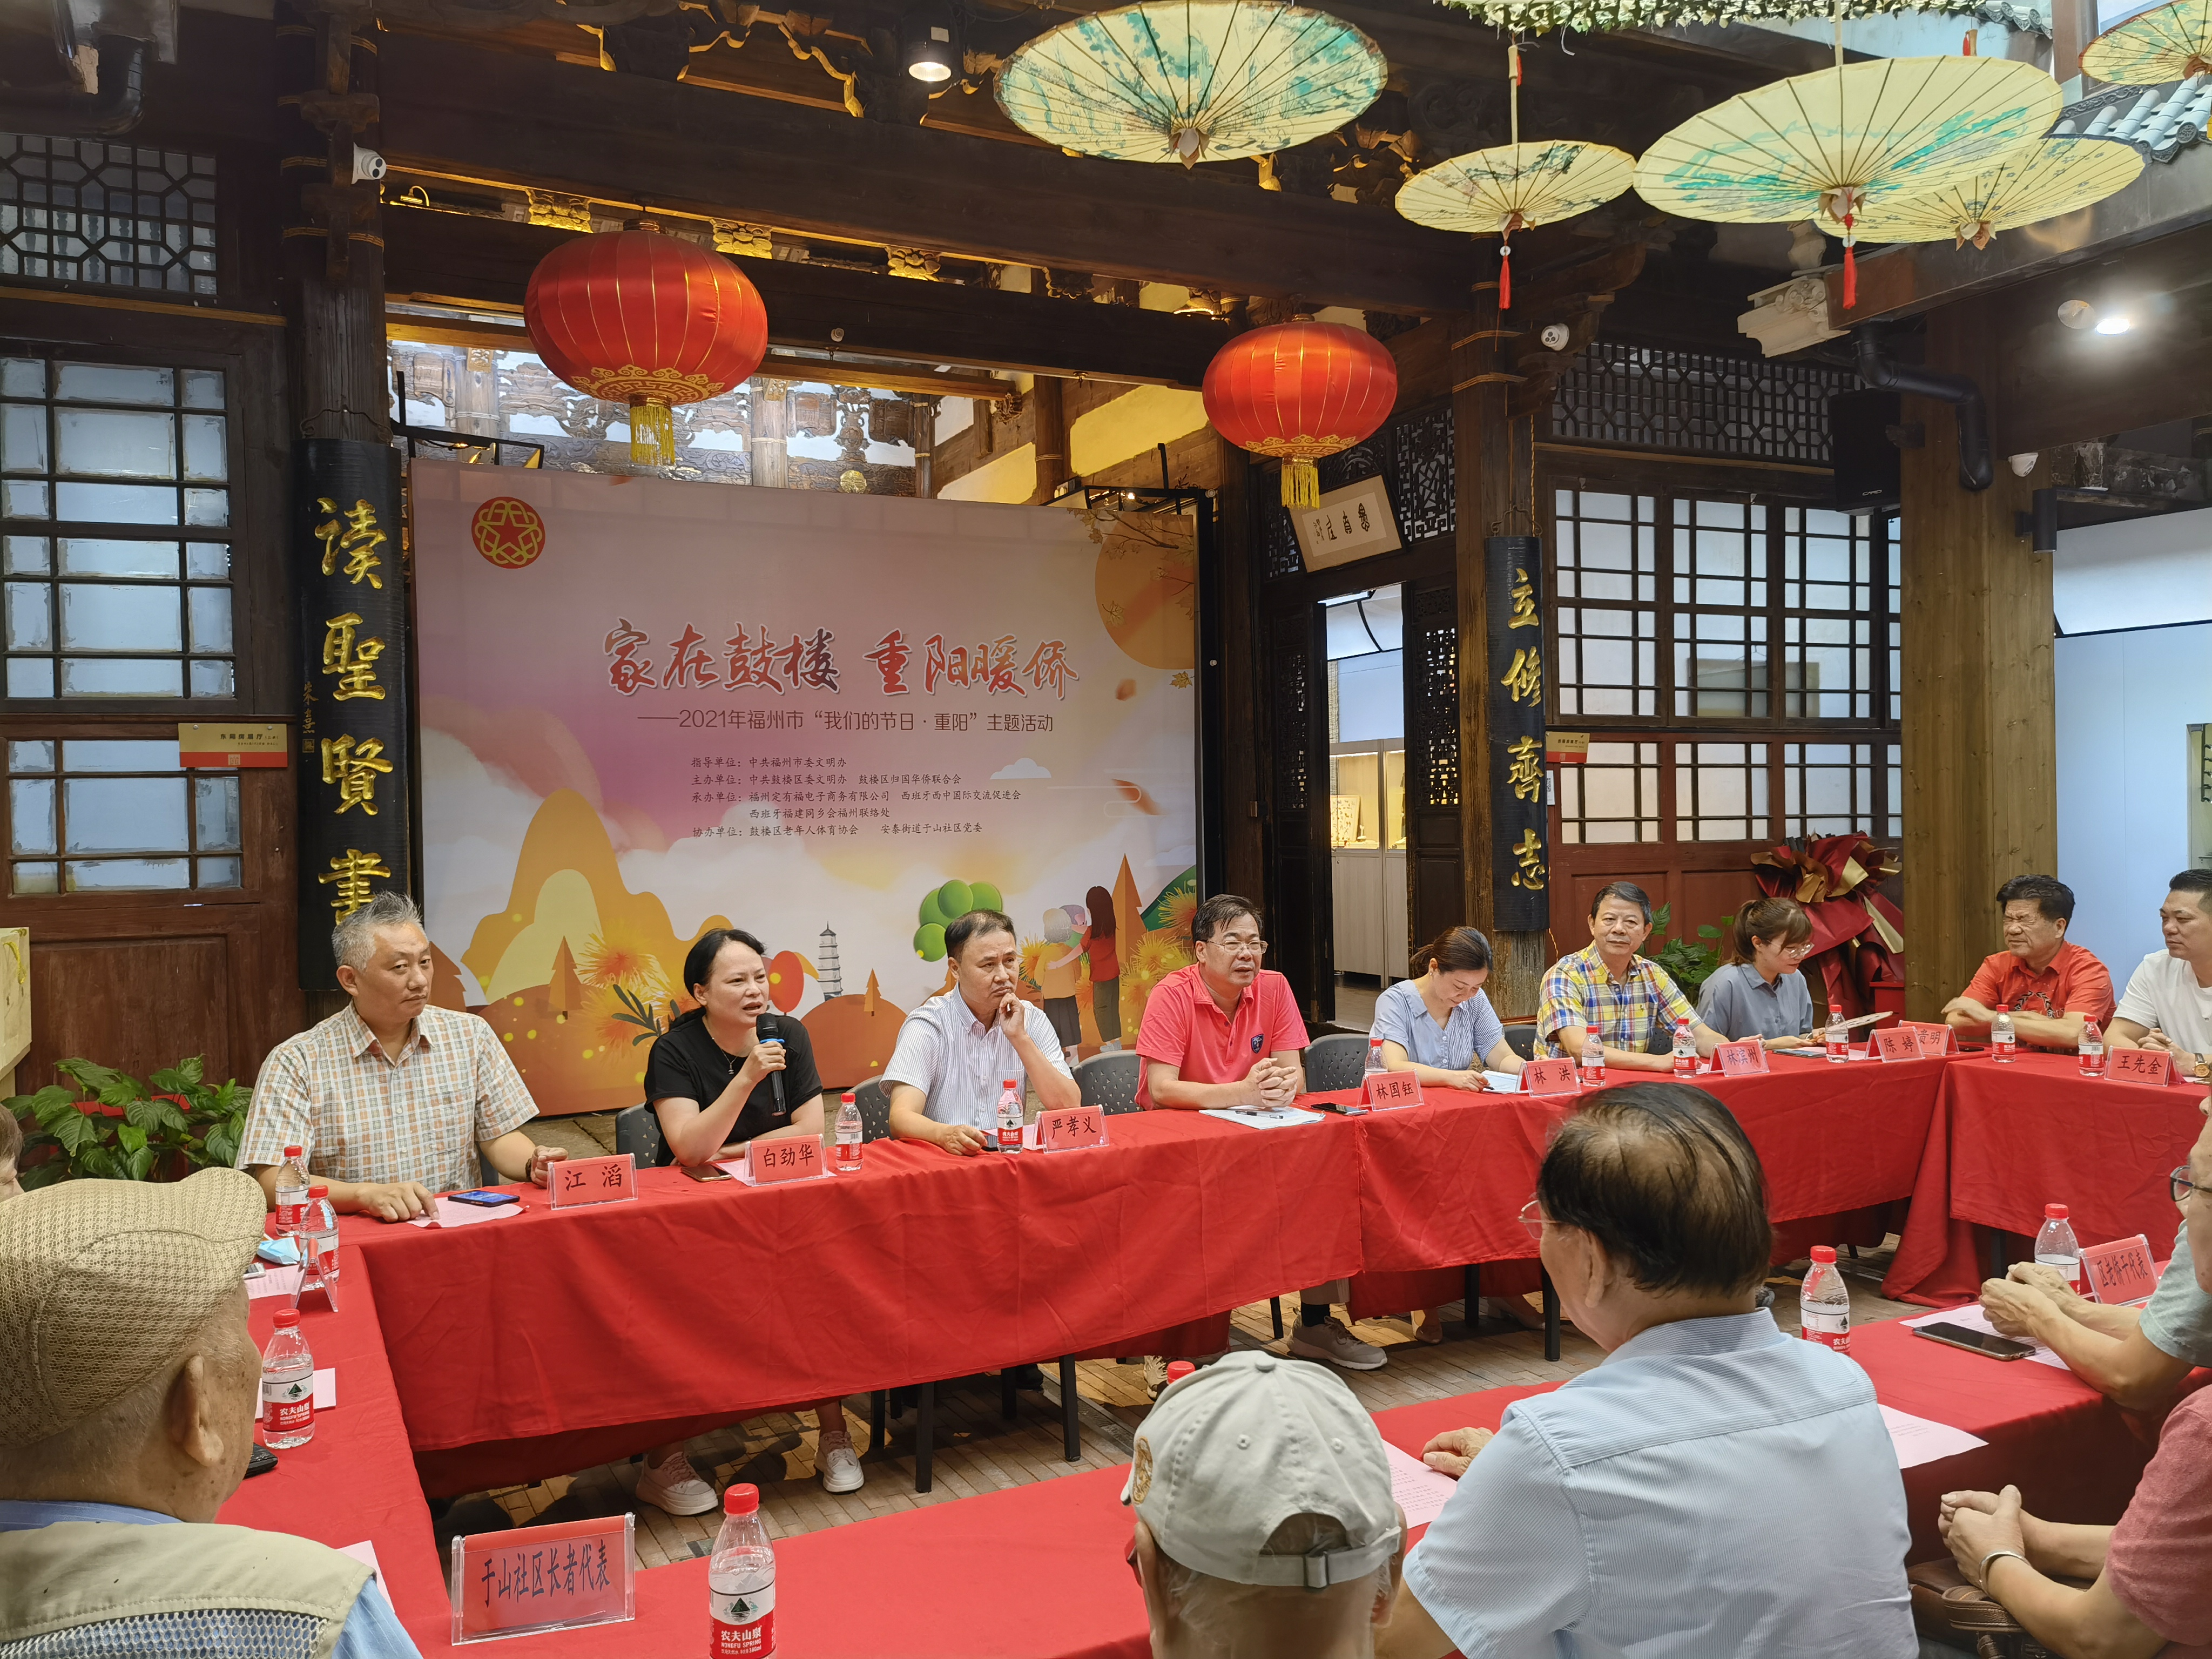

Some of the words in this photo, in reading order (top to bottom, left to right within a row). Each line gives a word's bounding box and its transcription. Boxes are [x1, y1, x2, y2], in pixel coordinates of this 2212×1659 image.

[603, 618, 840, 696] 家在鼓楼
[862, 628, 1079, 701] 重阳暖侨
[859, 774, 962, 785] 鼓楼区归国华侨联合会
[901, 790, 1021, 801] 西班牙西中国际交流促进会
[750, 807, 891, 819] 西班牙福建同乡会福州联络处
[880, 822, 983, 835] 安泰街道于山社区党委
[2117, 1055, 2162, 1075] 王先金
[1376, 1082, 1414, 1100] 林国钰
[1051, 1116, 1097, 1140] 严孝义
[763, 1144, 814, 1169] 白劲华
[482, 1539, 610, 1608] 于山社区长者代表
[720, 1627, 761, 1642] 农夫山泉
[743, 1638, 761, 1648] SPRING
